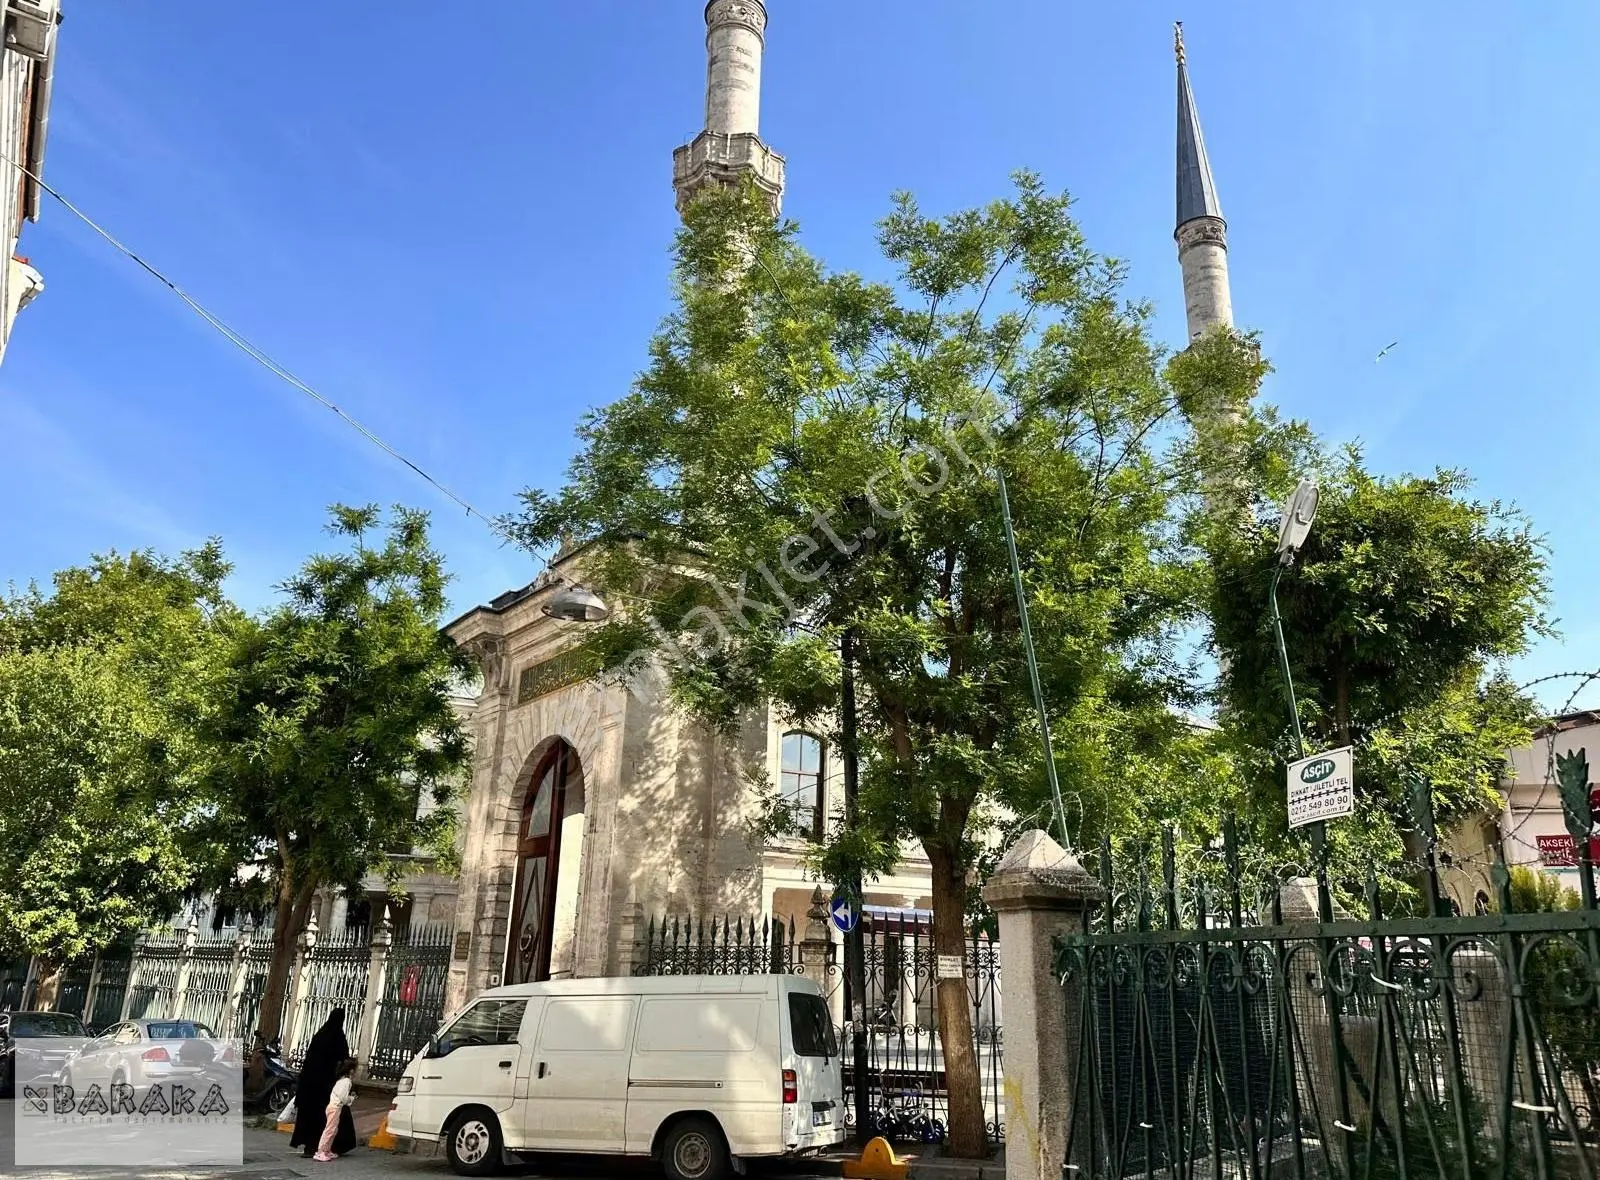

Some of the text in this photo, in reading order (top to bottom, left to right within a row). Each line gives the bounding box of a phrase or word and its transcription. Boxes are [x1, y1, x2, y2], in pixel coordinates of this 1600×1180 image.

[1337, 777, 1348, 785] TEL
[1291, 796, 1348, 815] 0212 549 80 90
